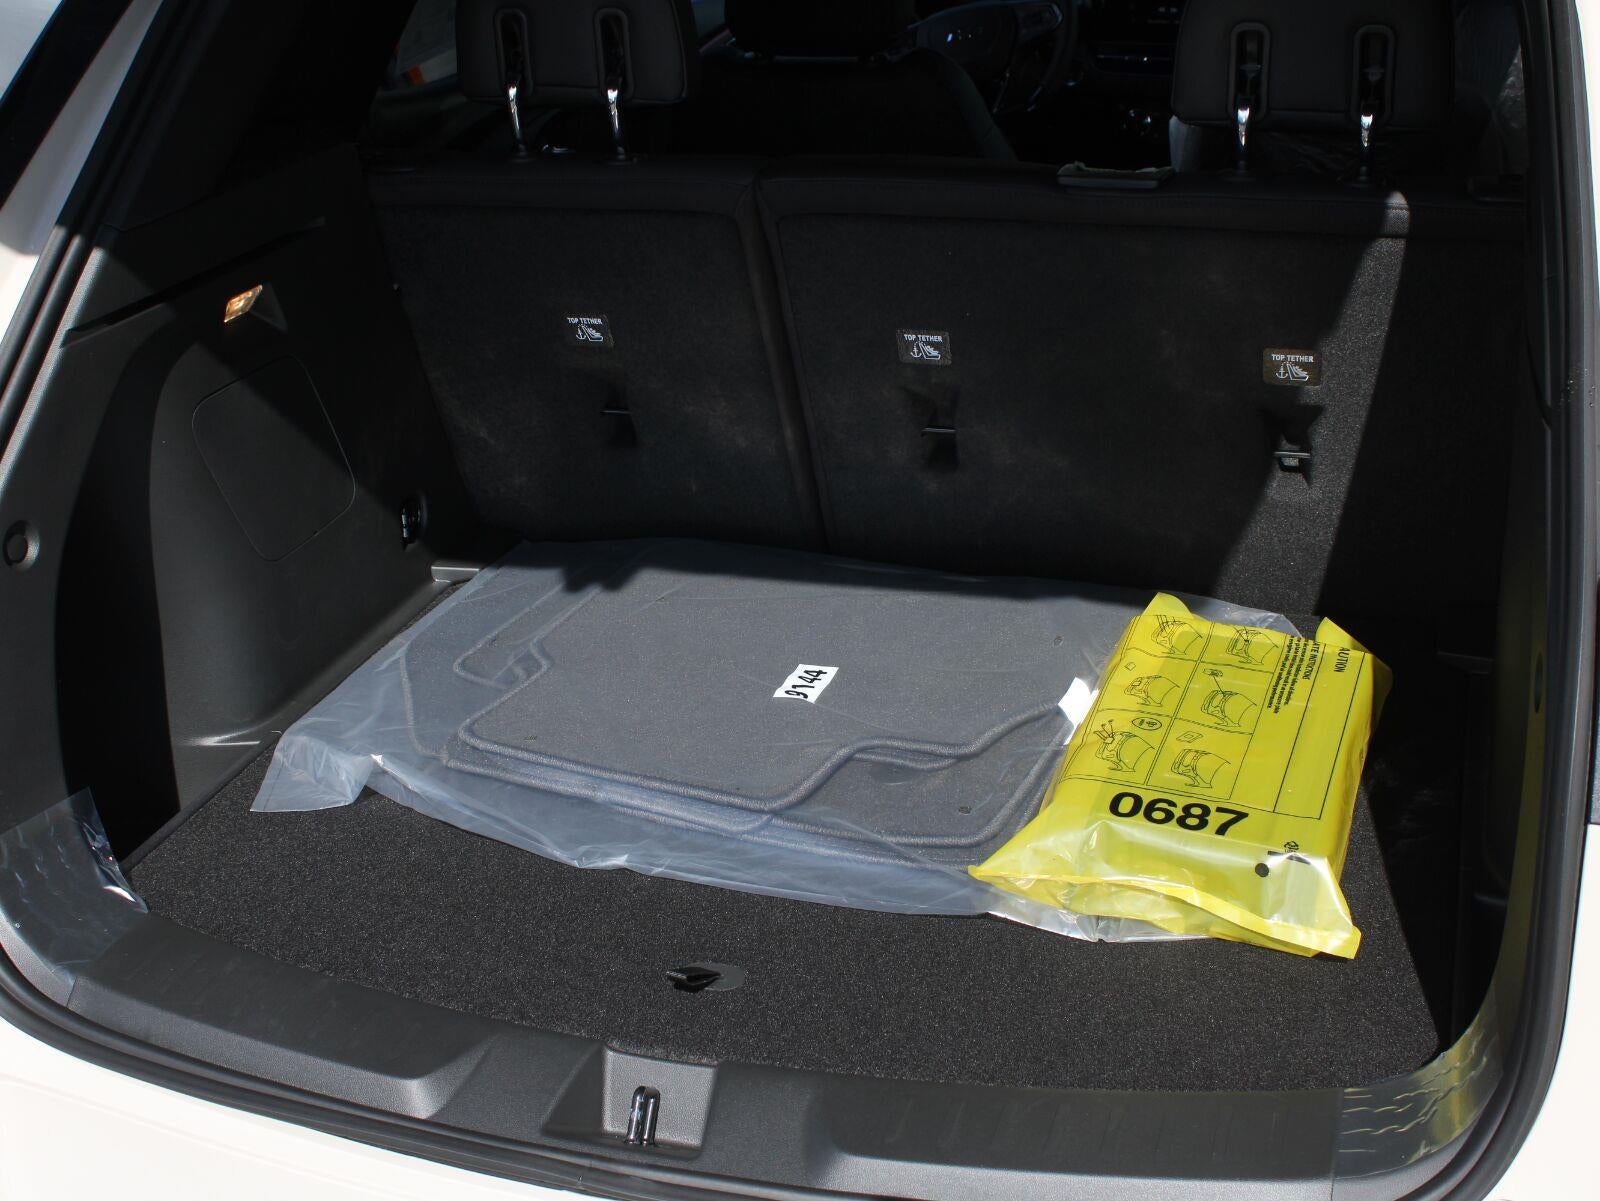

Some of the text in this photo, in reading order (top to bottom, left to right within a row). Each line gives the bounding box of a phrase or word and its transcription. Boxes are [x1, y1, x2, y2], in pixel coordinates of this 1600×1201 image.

[579, 317, 603, 325] TETHER
[917, 334, 943, 342] TETHER
[1286, 355, 1314, 363] TETHER
[1333, 646, 1351, 673] AUTION
[1108, 791, 1249, 836] 0687
